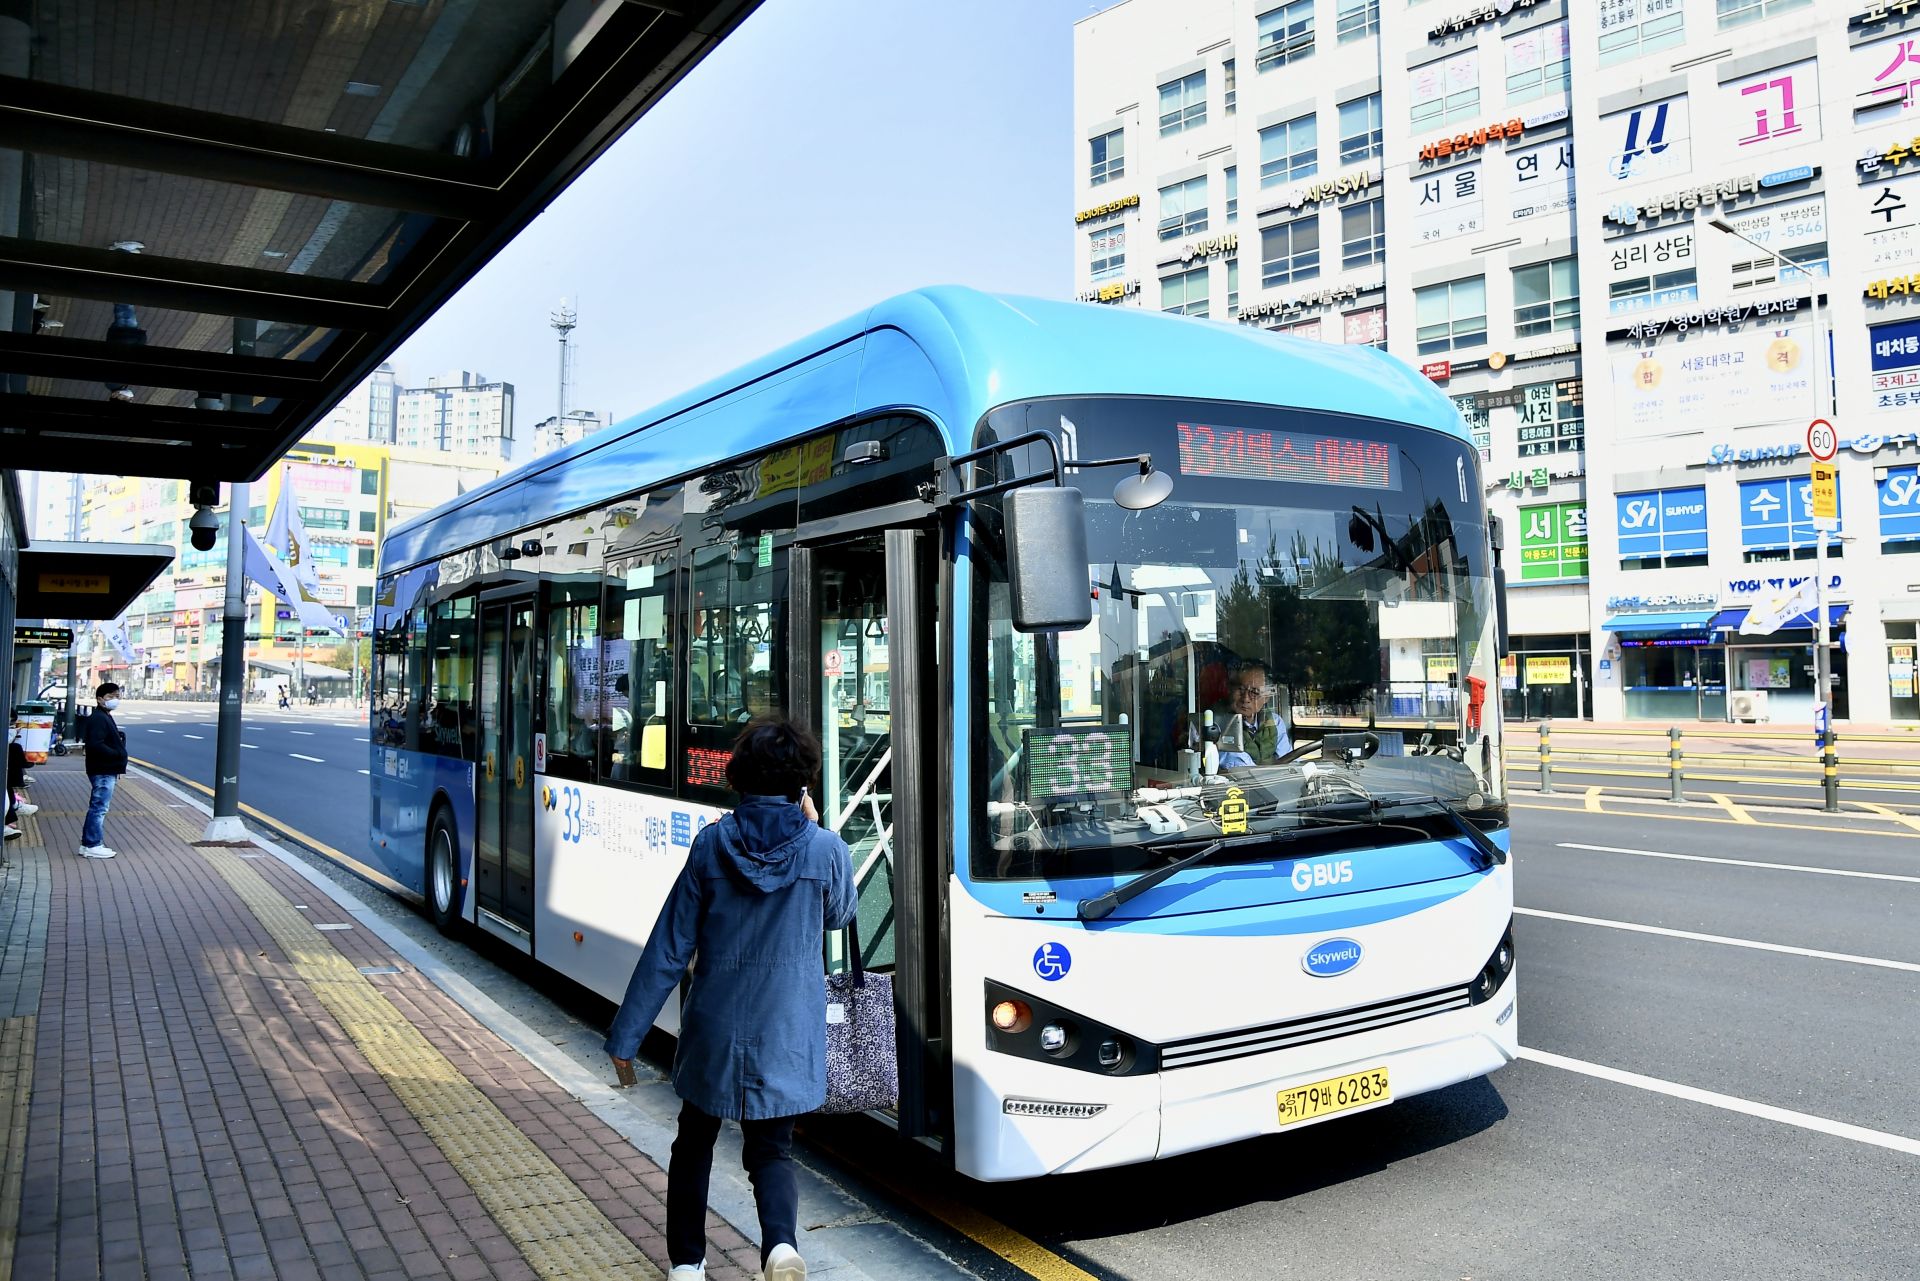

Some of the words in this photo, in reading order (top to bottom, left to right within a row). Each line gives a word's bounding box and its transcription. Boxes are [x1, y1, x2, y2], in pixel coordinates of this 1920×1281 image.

[1419, 118, 1525, 161] 서울연세학원
[1645, 174, 1760, 218] 심리상담센터
[1871, 187, 1906, 222] 수
[1780, 204, 1821, 222] 부부상담
[1611, 243, 1648, 271] 심리
[1653, 234, 1693, 261] 상담
[1875, 336, 1919, 357] 대치동
[1426, 363, 1446, 373] Photo
[1681, 351, 1745, 372] 서울대학교
[1777, 351, 1789, 365] 격
[1643, 371, 1653, 385] 합
[1876, 373, 1918, 388] 국제고
[1532, 386, 1551, 400] 여권
[1521, 401, 1552, 424] 사진
[1526, 442, 1550, 456] 사진
[1813, 430, 1831, 450] 60
[1707, 443, 1735, 466] Sh
[1739, 443, 1802, 462] SUHYUP
[1506, 467, 1550, 490] 서점
[1621, 500, 1657, 529] Sh
[1665, 504, 1704, 517] SUHYUP
[1049, 732, 1112, 795] 33
[563, 785, 582, 844] 33
[1310, 946, 1359, 967] Skywell
[1337, 1073, 1383, 1106] 6283
